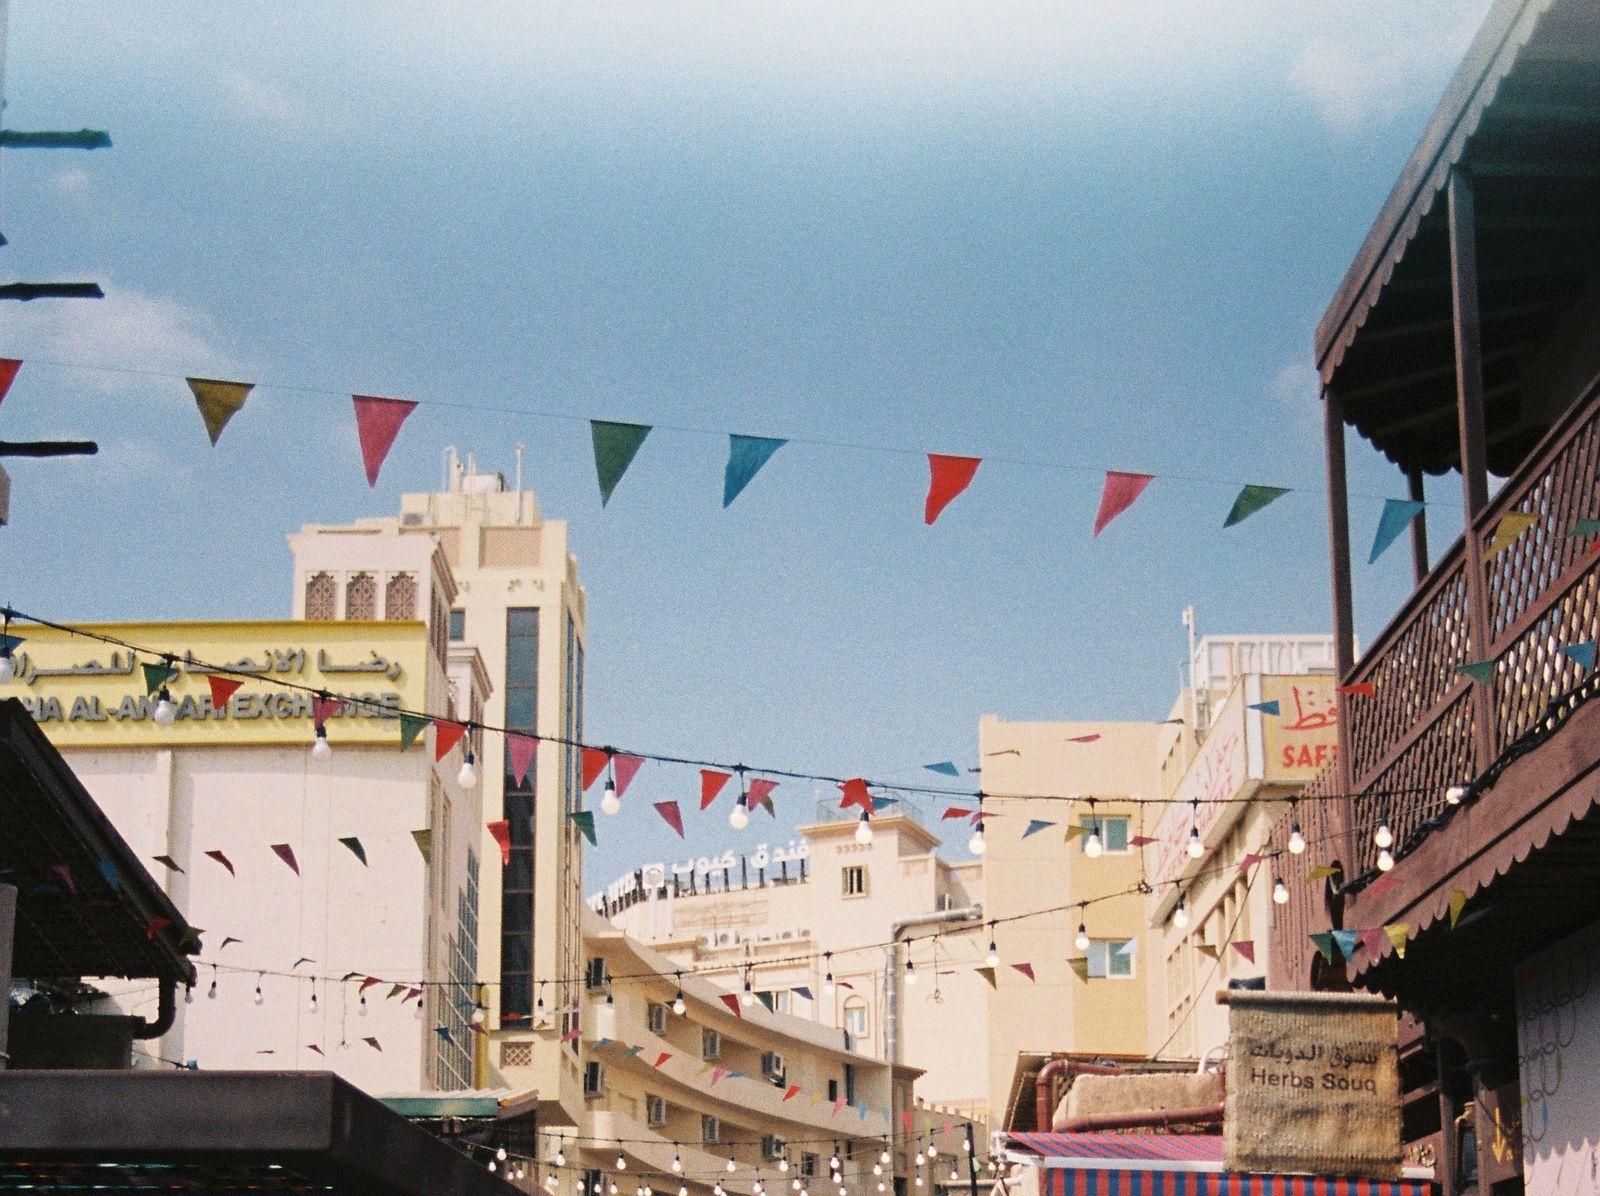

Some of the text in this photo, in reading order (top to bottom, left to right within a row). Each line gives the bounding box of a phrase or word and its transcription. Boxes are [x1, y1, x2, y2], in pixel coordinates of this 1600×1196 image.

[69, 695, 227, 721] AL-ANARI
[232, 692, 402, 719] EXCHNGE
[1250, 1067, 1378, 1095] Herbs Souq
